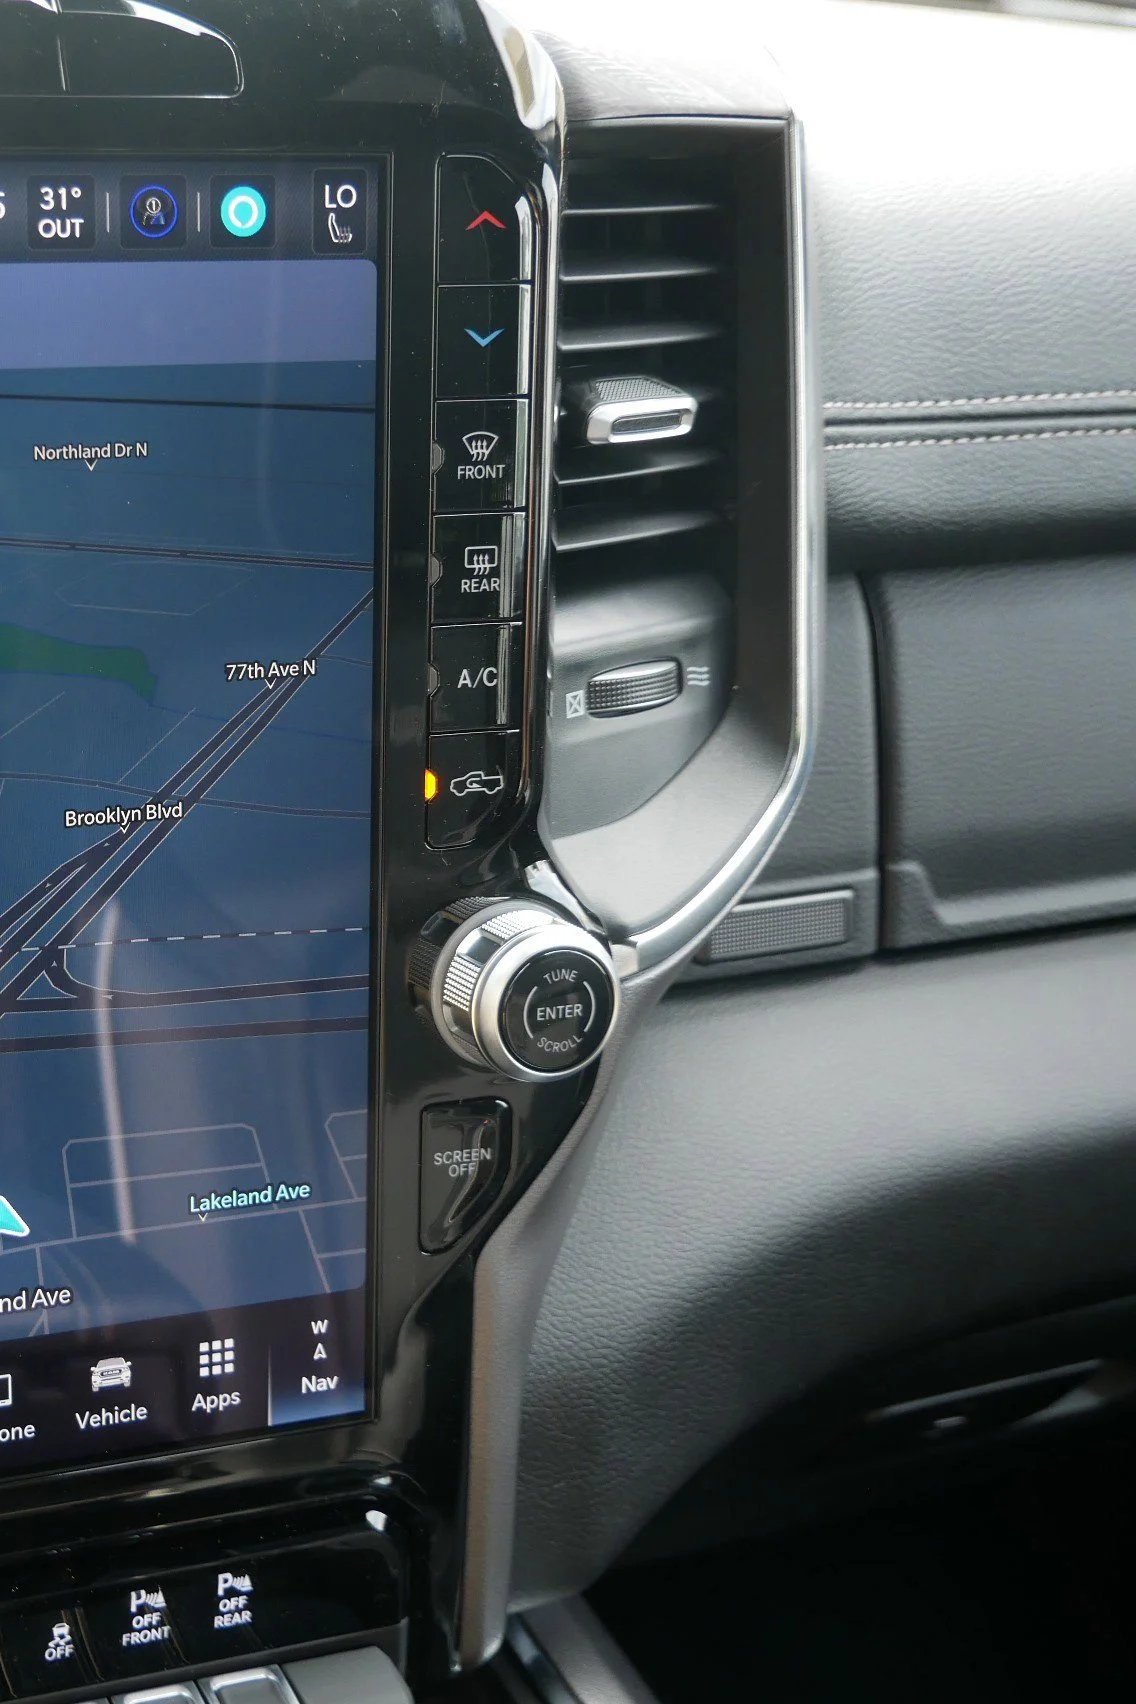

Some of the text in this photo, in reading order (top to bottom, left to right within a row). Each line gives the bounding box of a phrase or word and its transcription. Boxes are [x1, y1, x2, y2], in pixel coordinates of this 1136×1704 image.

[39, 187, 82, 211] 31°
[324, 184, 357, 209] LO
[38, 219, 84, 239] OUT
[33, 442, 148, 461] Northland Dr N
[457, 464, 505, 480] FRONT
[461, 578, 500, 593] REAR
[226, 659, 316, 680] 77th Ave N
[457, 667, 498, 689] A/C
[65, 802, 183, 828] Brooklyn Blvd
[543, 968, 579, 985] TUNE
[536, 1003, 583, 1021] ENTER
[536, 1034, 584, 1053] SCROLL
[433, 1148, 492, 1166] SCREEN
[448, 1162, 476, 1178] OFF
[190, 1182, 311, 1213] Lakeland Ave
[31, 1287, 72, 1309] Ave
[301, 1375, 339, 1394] Nav
[191, 1389, 241, 1413] Apps
[75, 1404, 148, 1430] Vehicle
[218, 1594, 249, 1613] OFF
[132, 1611, 163, 1630] OFF
[214, 1610, 252, 1629] REAR
[122, 1625, 171, 1647] FRONT
[45, 1644, 74, 1662] OFF
